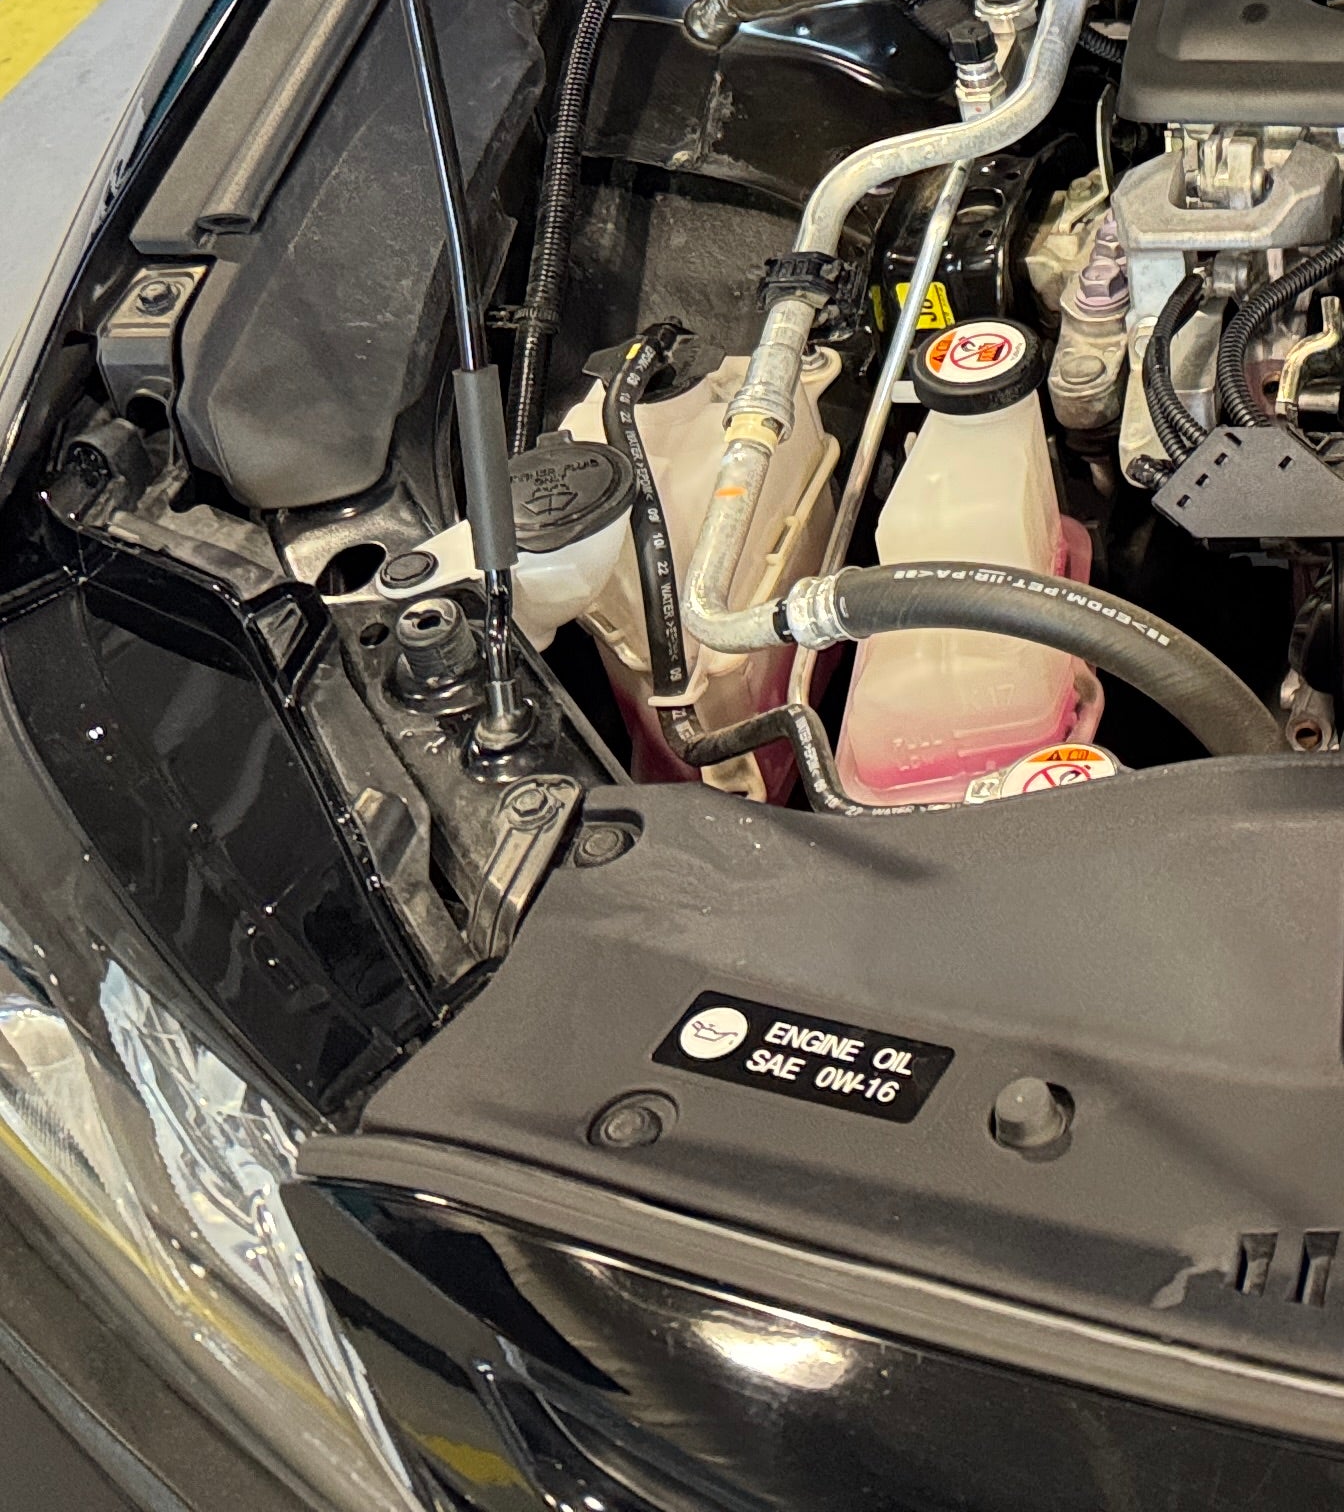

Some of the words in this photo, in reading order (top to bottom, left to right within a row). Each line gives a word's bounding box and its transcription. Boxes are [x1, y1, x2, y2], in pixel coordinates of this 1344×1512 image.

[656, 560, 670, 577] 22
[660, 582, 676, 620] WATER
[765, 1020, 865, 1063] ENGINE
[872, 1047, 913, 1077] OIL
[746, 1049, 806, 1080] SAE
[815, 1066, 900, 1104] 0W-16
